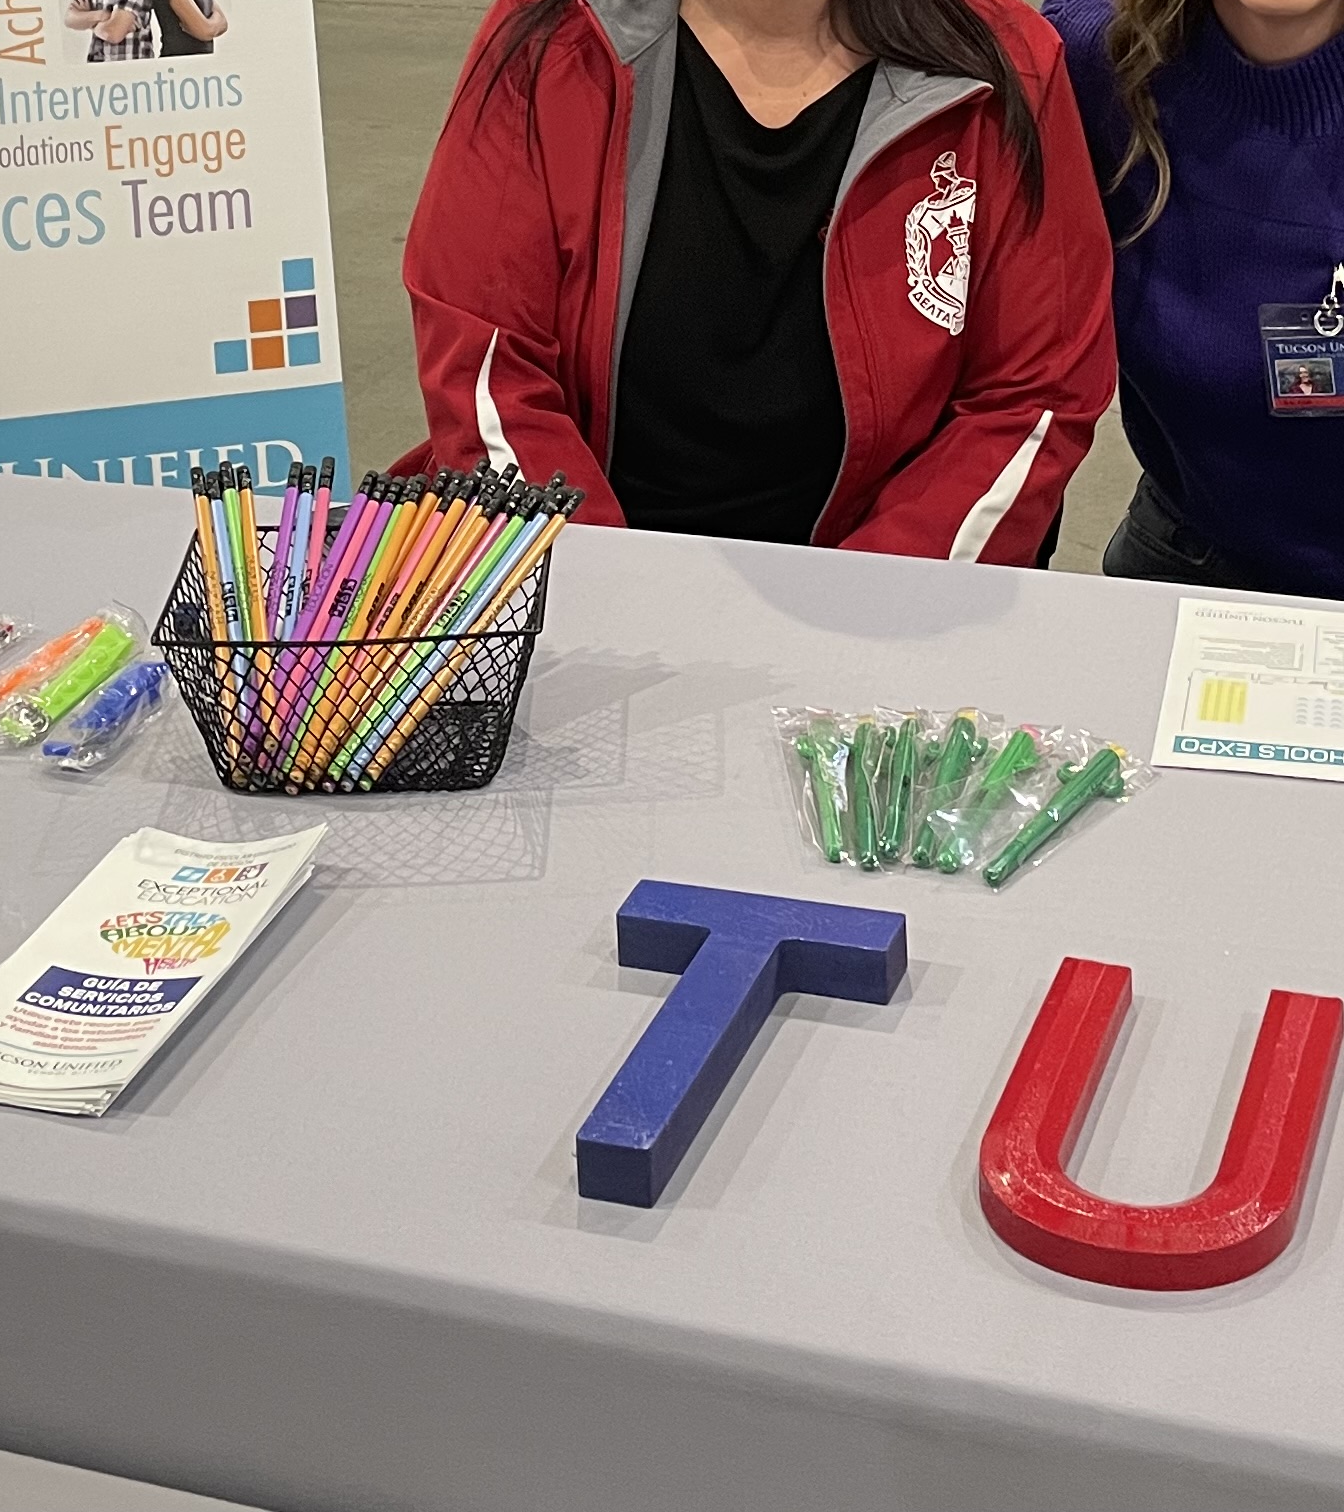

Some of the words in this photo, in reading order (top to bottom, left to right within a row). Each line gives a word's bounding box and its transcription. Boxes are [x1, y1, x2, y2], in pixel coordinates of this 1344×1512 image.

[103, 123, 248, 178] Engage
[120, 176, 254, 239] Team
[1275, 343, 1327, 355] TUCSON
[1180, 738, 1252, 758] EXPO
[137, 878, 270, 897] EXCEPTIONAL
[136, 890, 259, 906] EDUCATION
[100, 911, 165, 930] LET'S
[164, 911, 228, 928] TALK
[100, 924, 207, 943] ABOUT
[111, 919, 232, 959] MENTAL
[82, 976, 132, 991] GUÍA
[132, 980, 164, 992] DE
[24, 991, 177, 1016] COMUNITARIOS
[57, 986, 165, 1004] SERVICIOS
[52, 1059, 123, 1071] UNIFIED
